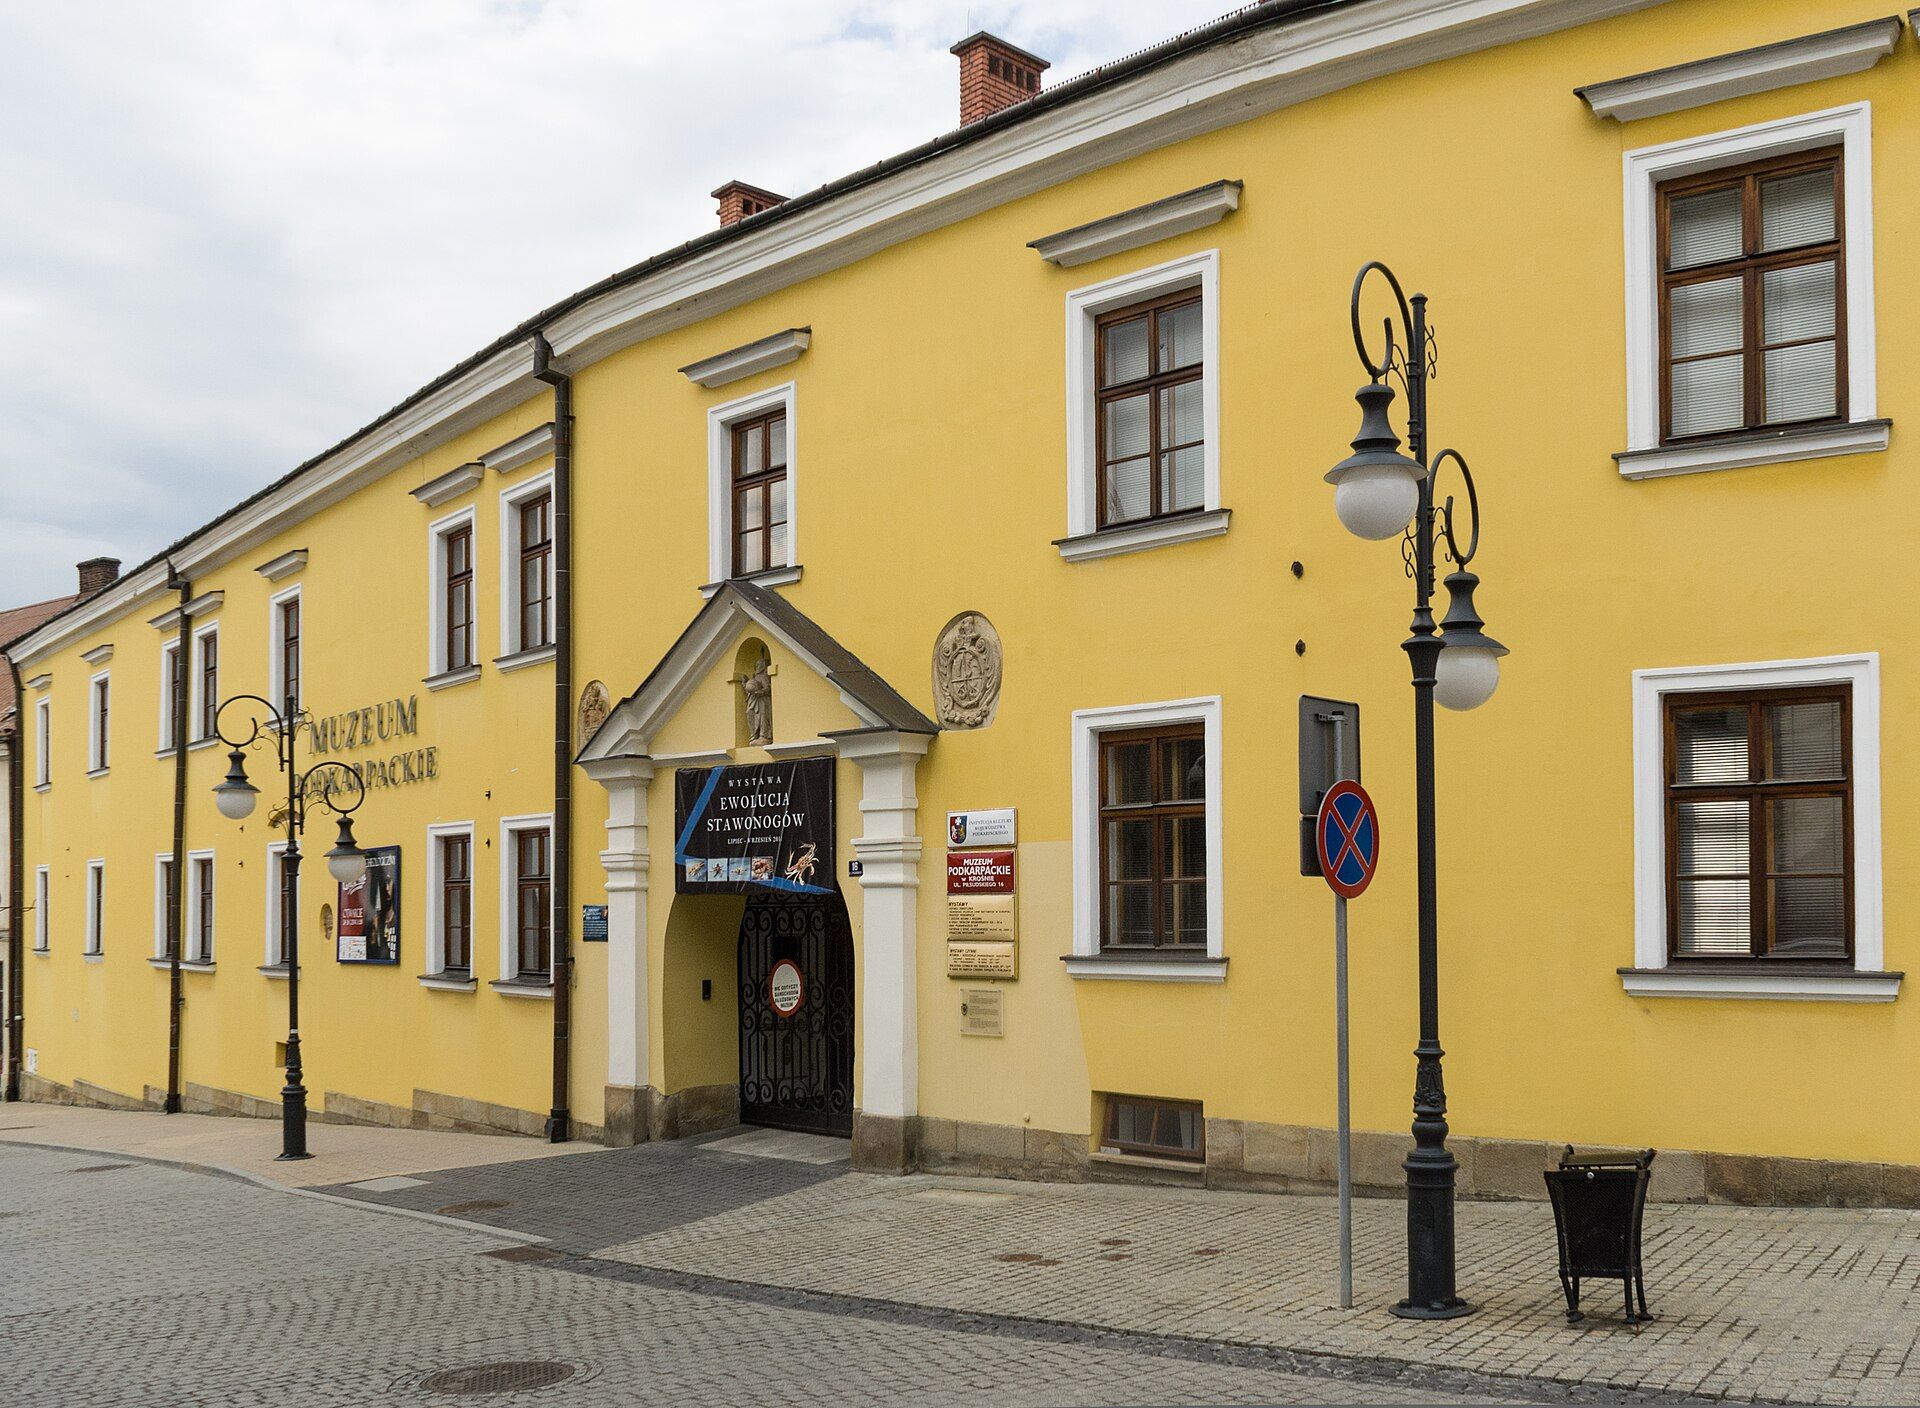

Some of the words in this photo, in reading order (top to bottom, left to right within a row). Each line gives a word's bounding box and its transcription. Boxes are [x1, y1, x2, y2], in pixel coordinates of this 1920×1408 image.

[308, 694, 417, 754] MUZEUM
[292, 746, 437, 796] PODKARPACKIE
[728, 775, 782, 787] WYSTAWA
[720, 792, 790, 810] EWOLUCJA
[707, 811, 805, 832] STAWONOGÓW
[727, 837, 744, 845] LIPIEC
[963, 858, 993, 866] MUZEUM
[948, 865, 1011, 876] PODKARPACKIE
